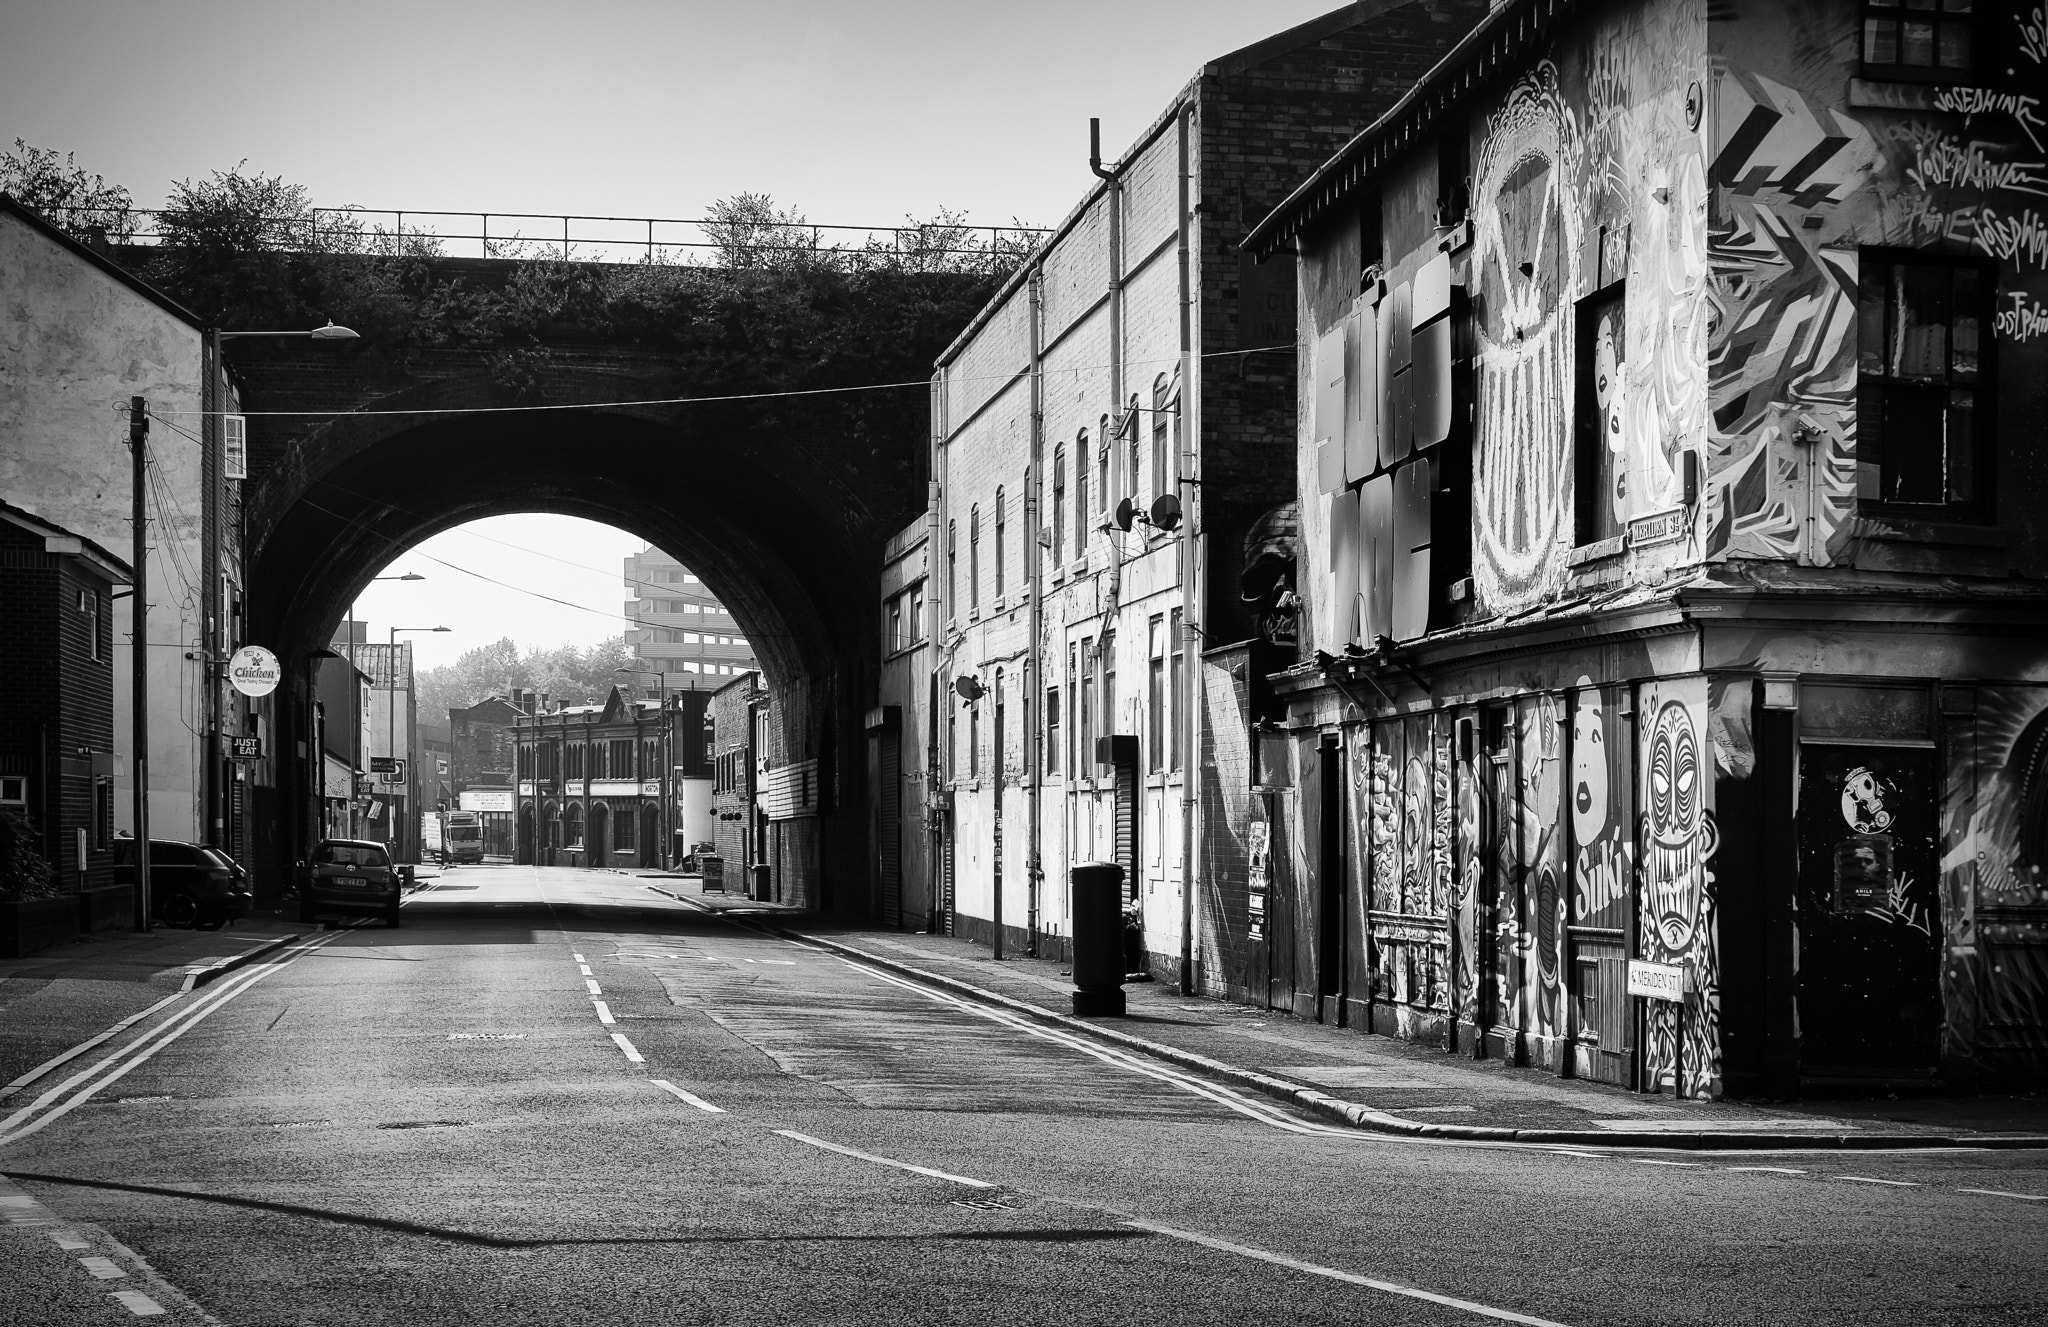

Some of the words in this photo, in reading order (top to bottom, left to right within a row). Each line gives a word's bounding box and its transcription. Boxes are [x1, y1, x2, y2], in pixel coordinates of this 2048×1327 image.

[1253, 320, 1298, 340] UND
[235, 667, 275, 679] Chicken
[234, 738, 257, 747] JUST
[239, 747, 257, 755] EAT
[1637, 970, 1667, 989] MERIDEN
